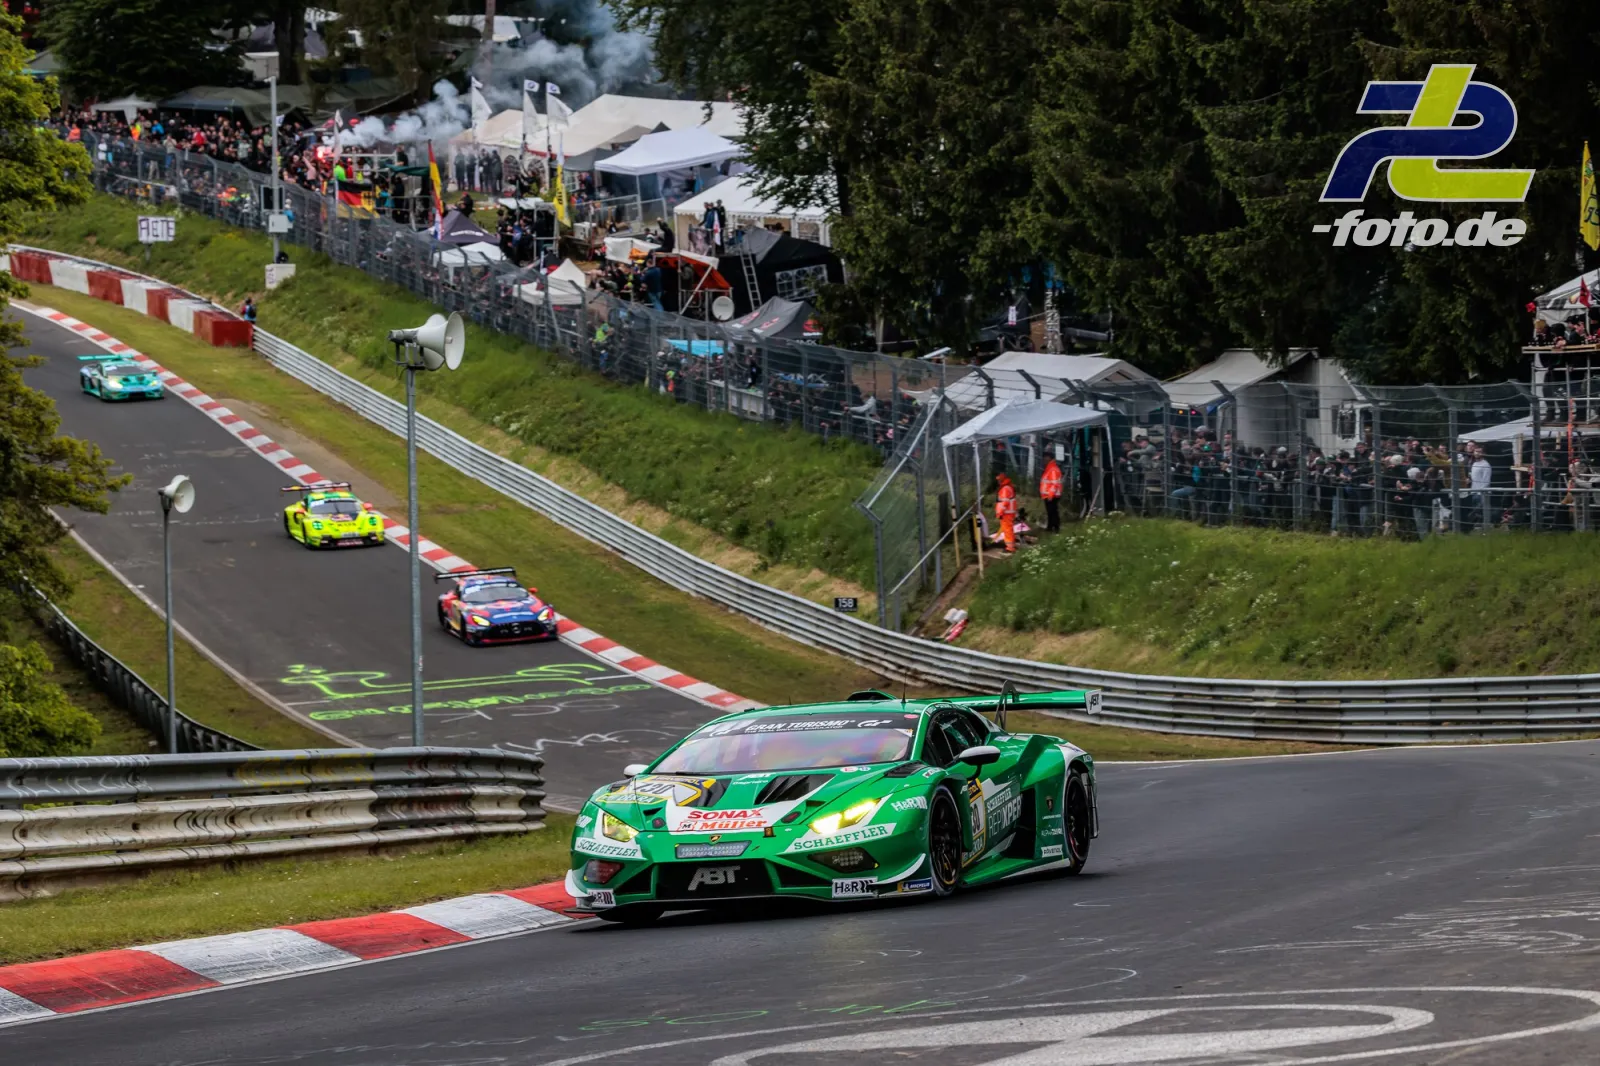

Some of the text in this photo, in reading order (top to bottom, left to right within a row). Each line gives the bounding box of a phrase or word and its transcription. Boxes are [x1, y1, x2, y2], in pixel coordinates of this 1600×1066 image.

[838, 599, 854, 608] 158
[745, 722, 788, 732] GRAN
[687, 808, 764, 820] SONAX
[988, 793, 1023, 838] REPXPER
[700, 819, 767, 830] Müller
[794, 825, 889, 850] SCHAEFFLER
[577, 839, 639, 857] SCHAEFFLER
[687, 865, 741, 891] ABT
[835, 880, 859, 893] H&R
